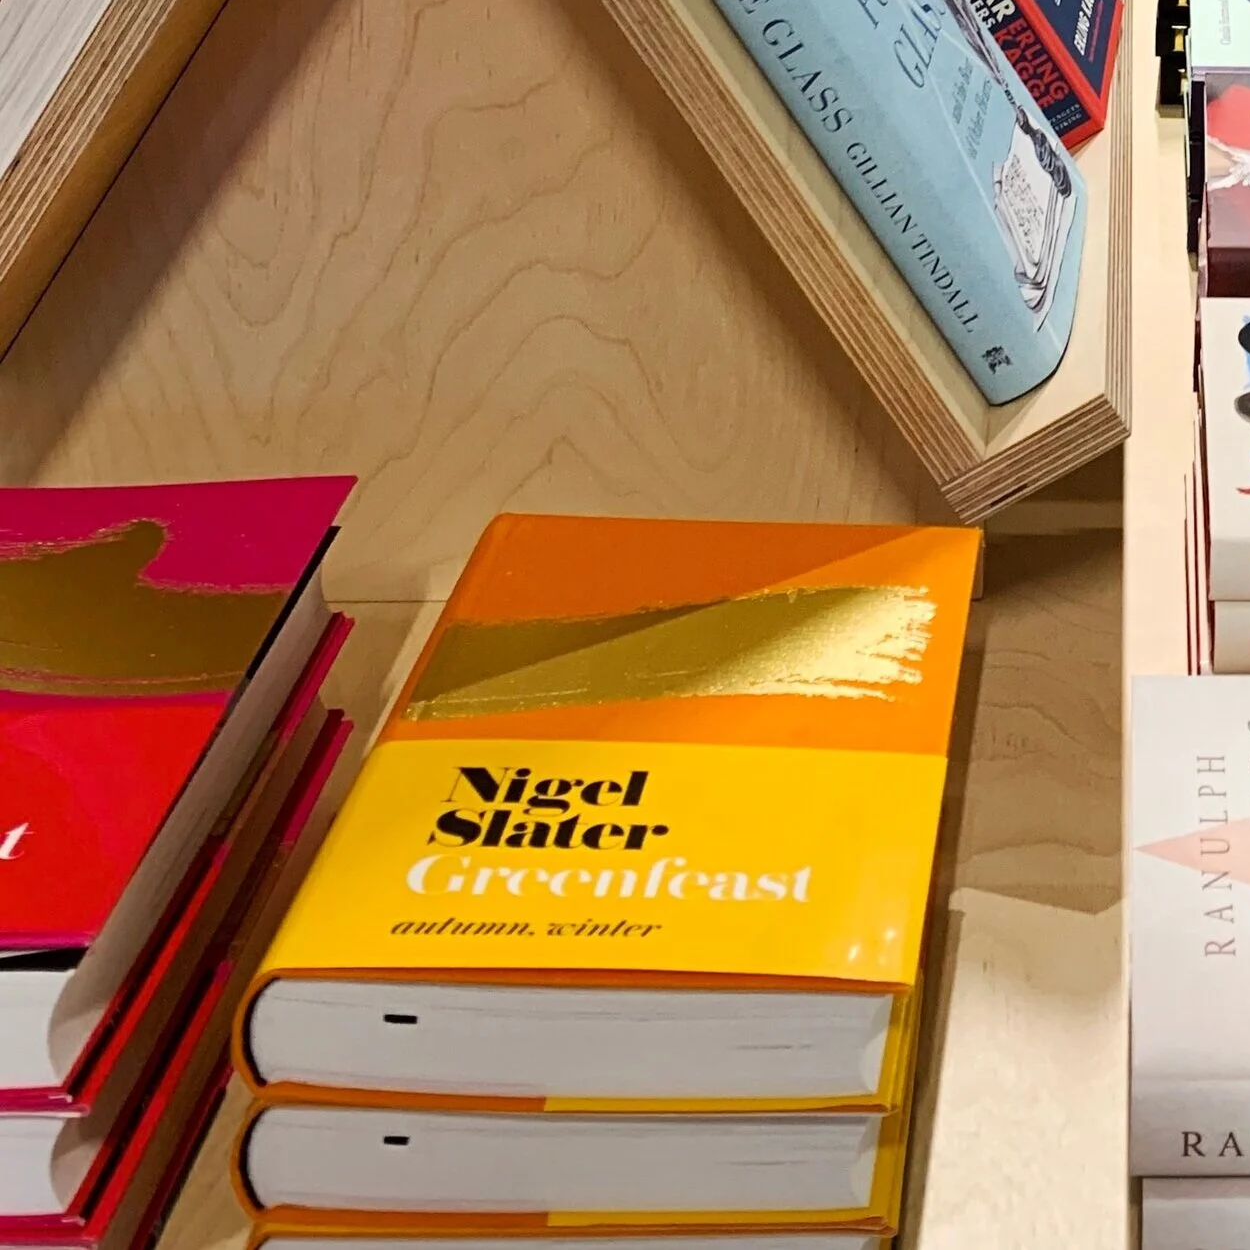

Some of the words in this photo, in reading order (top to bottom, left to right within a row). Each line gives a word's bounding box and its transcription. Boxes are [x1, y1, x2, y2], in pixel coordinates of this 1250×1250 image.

[1008, 17, 1070, 100] ERLING
[763, 18, 853, 133] GLASS
[847, 139, 918, 234] GILLIAN
[909, 229, 978, 334] TINDALL
[443, 765, 649, 816] Nigel
[426, 809, 670, 852] Slater
[1195, 752, 1237, 960] RANULPH
[405, 852, 813, 905] Greenfeast
[389, 916, 538, 940] autumn,
[545, 916, 664, 940] winter
